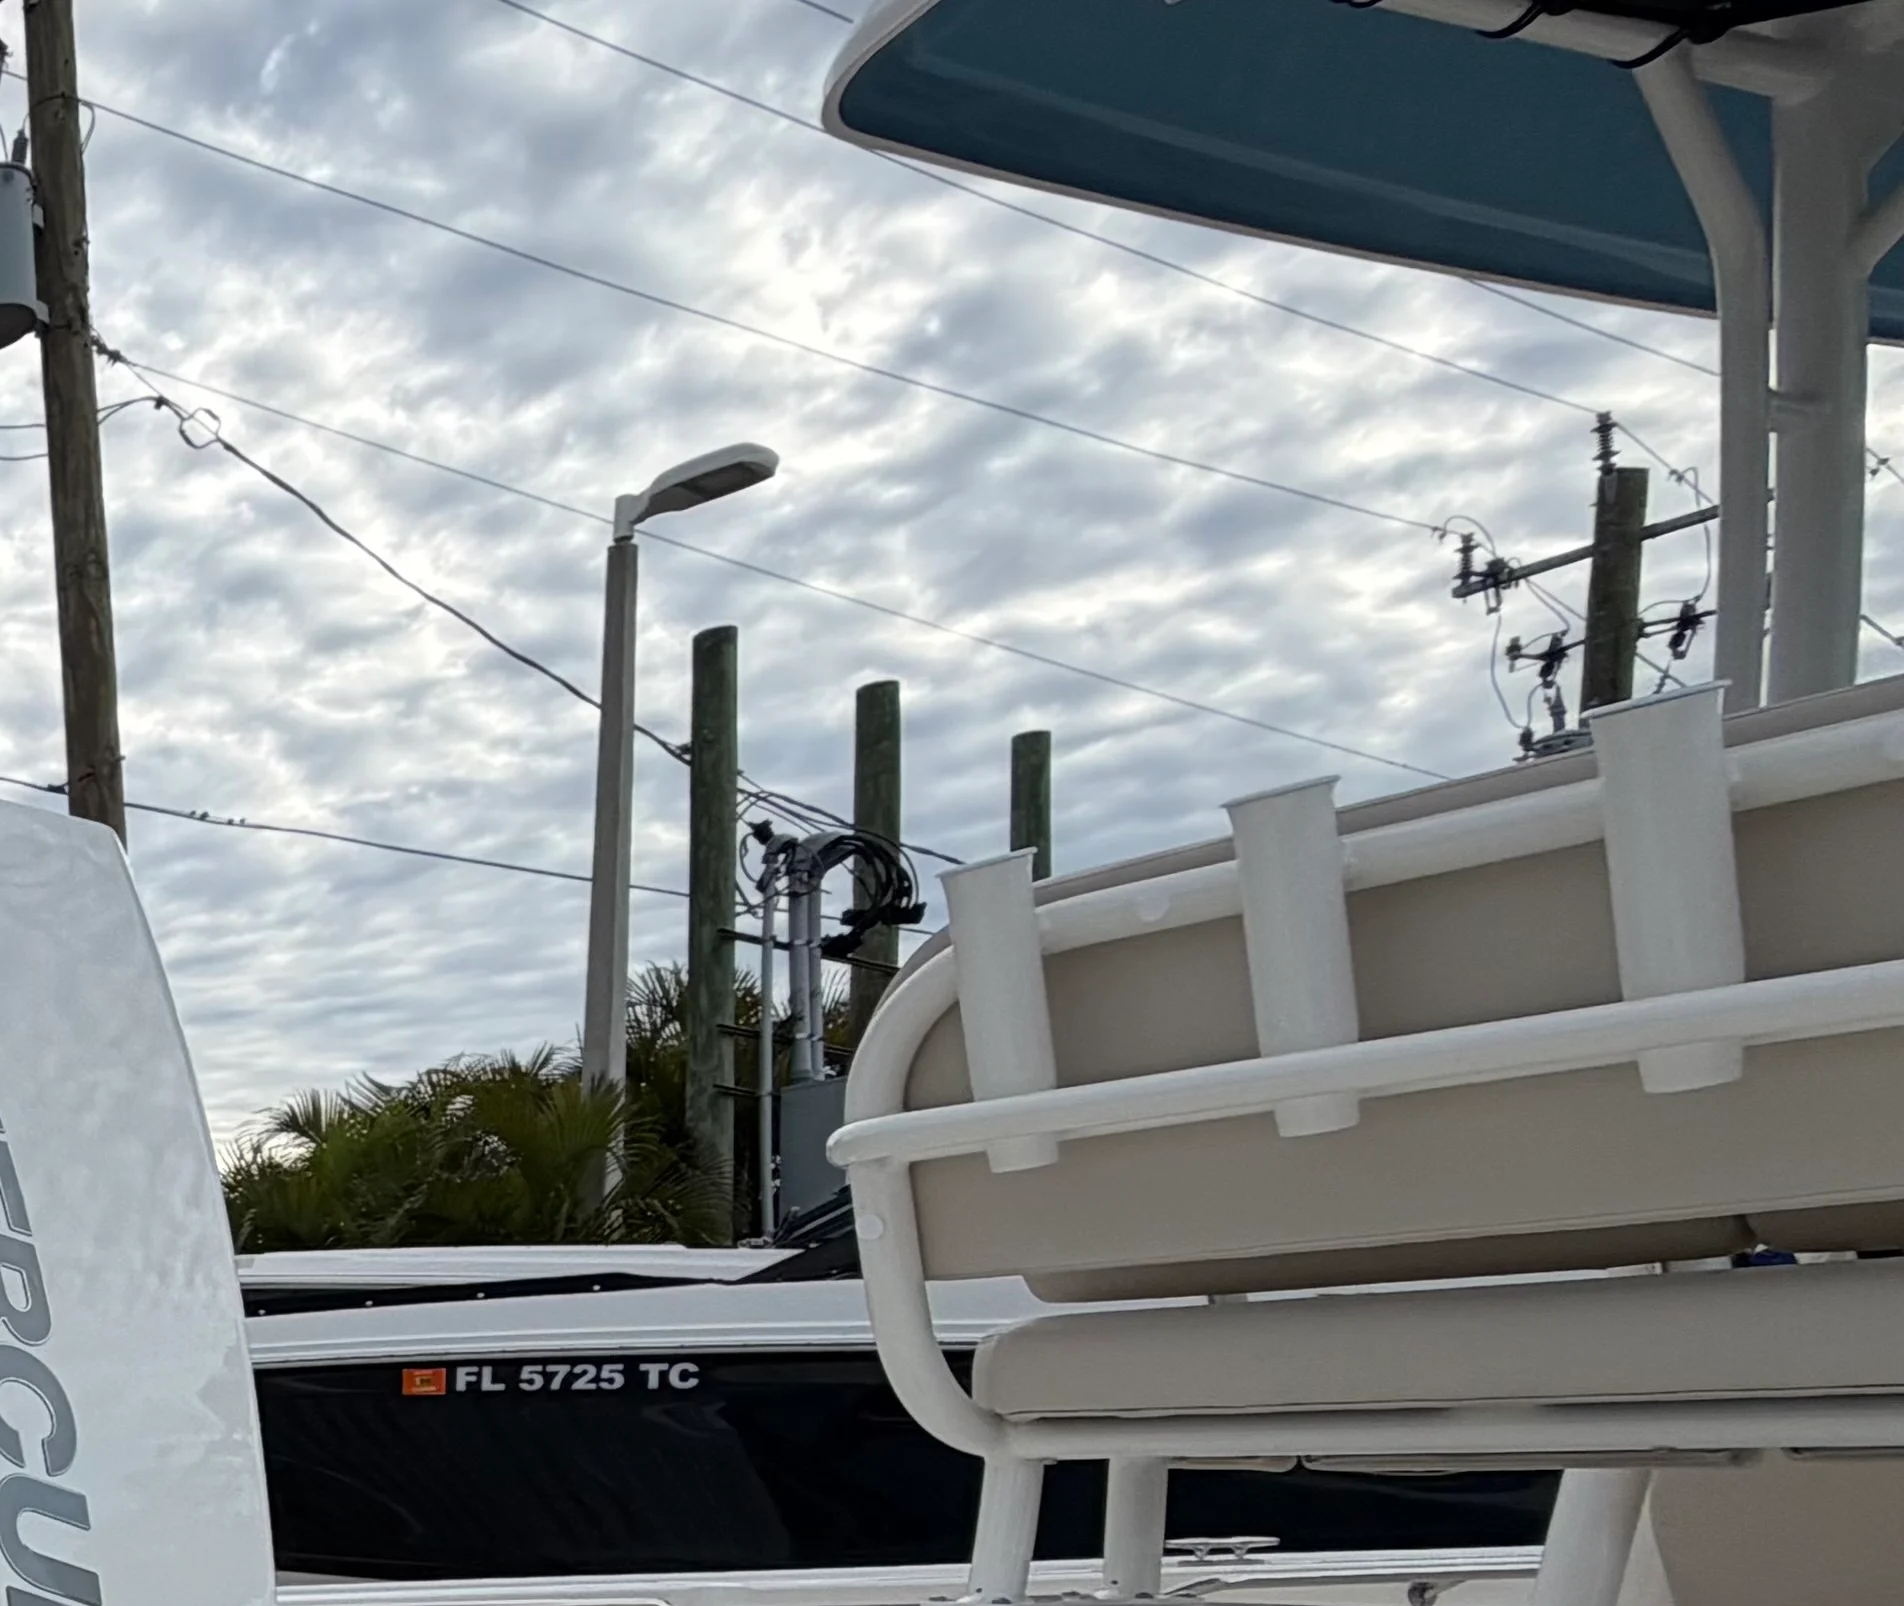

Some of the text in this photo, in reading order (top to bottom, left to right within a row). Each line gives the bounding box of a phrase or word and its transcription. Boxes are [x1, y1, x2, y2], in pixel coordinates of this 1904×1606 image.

[455, 1366, 506, 1392] FL
[518, 1363, 625, 1391] 5725
[639, 1362, 700, 1390] TC
